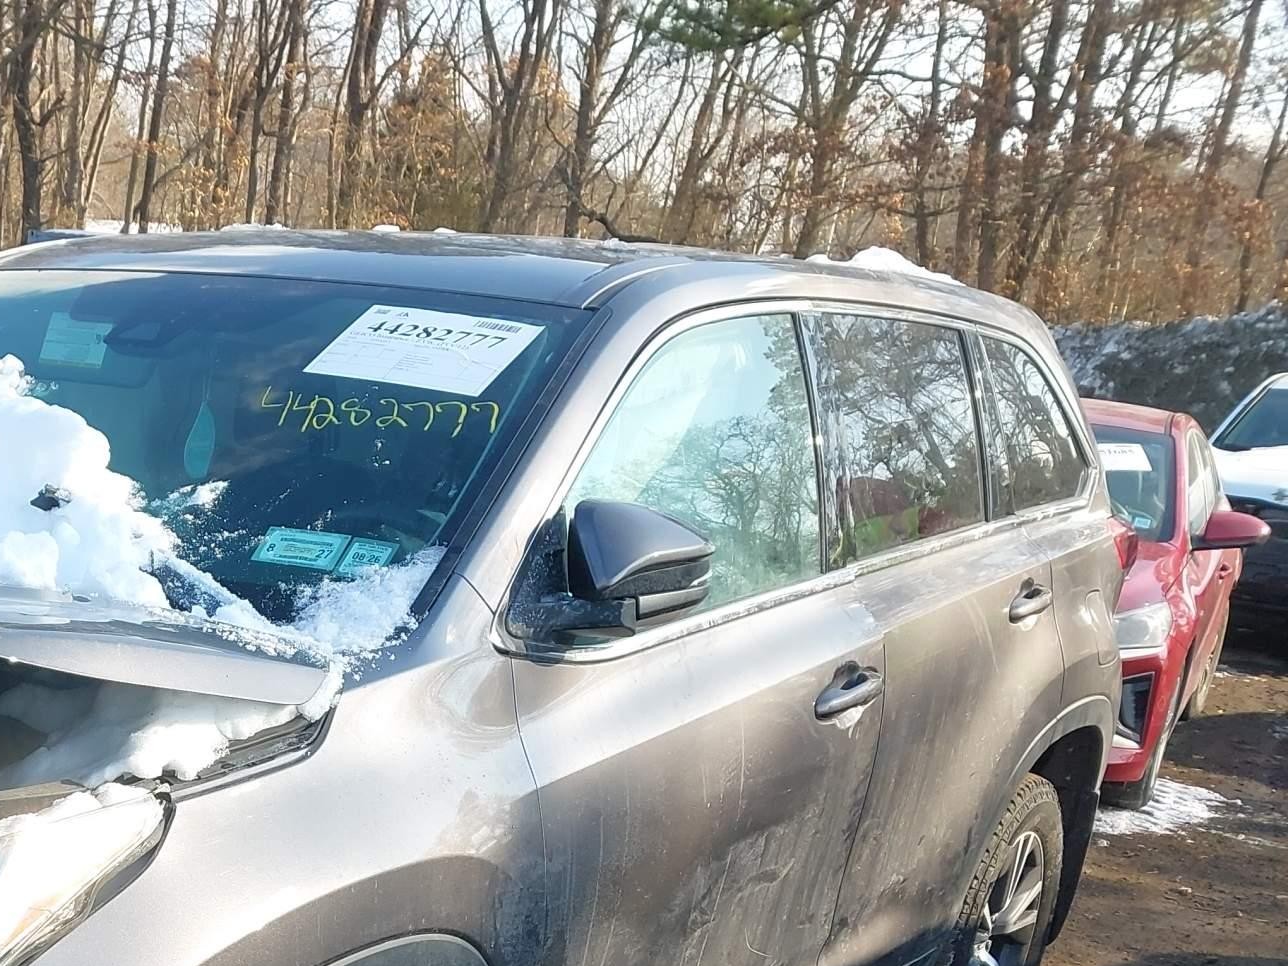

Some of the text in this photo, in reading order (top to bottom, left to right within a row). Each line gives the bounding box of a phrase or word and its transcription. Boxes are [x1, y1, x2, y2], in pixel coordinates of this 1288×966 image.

[367, 320, 508, 348] 44282777
[262, 385, 500, 438] 44282777
[315, 549, 333, 560] 27
